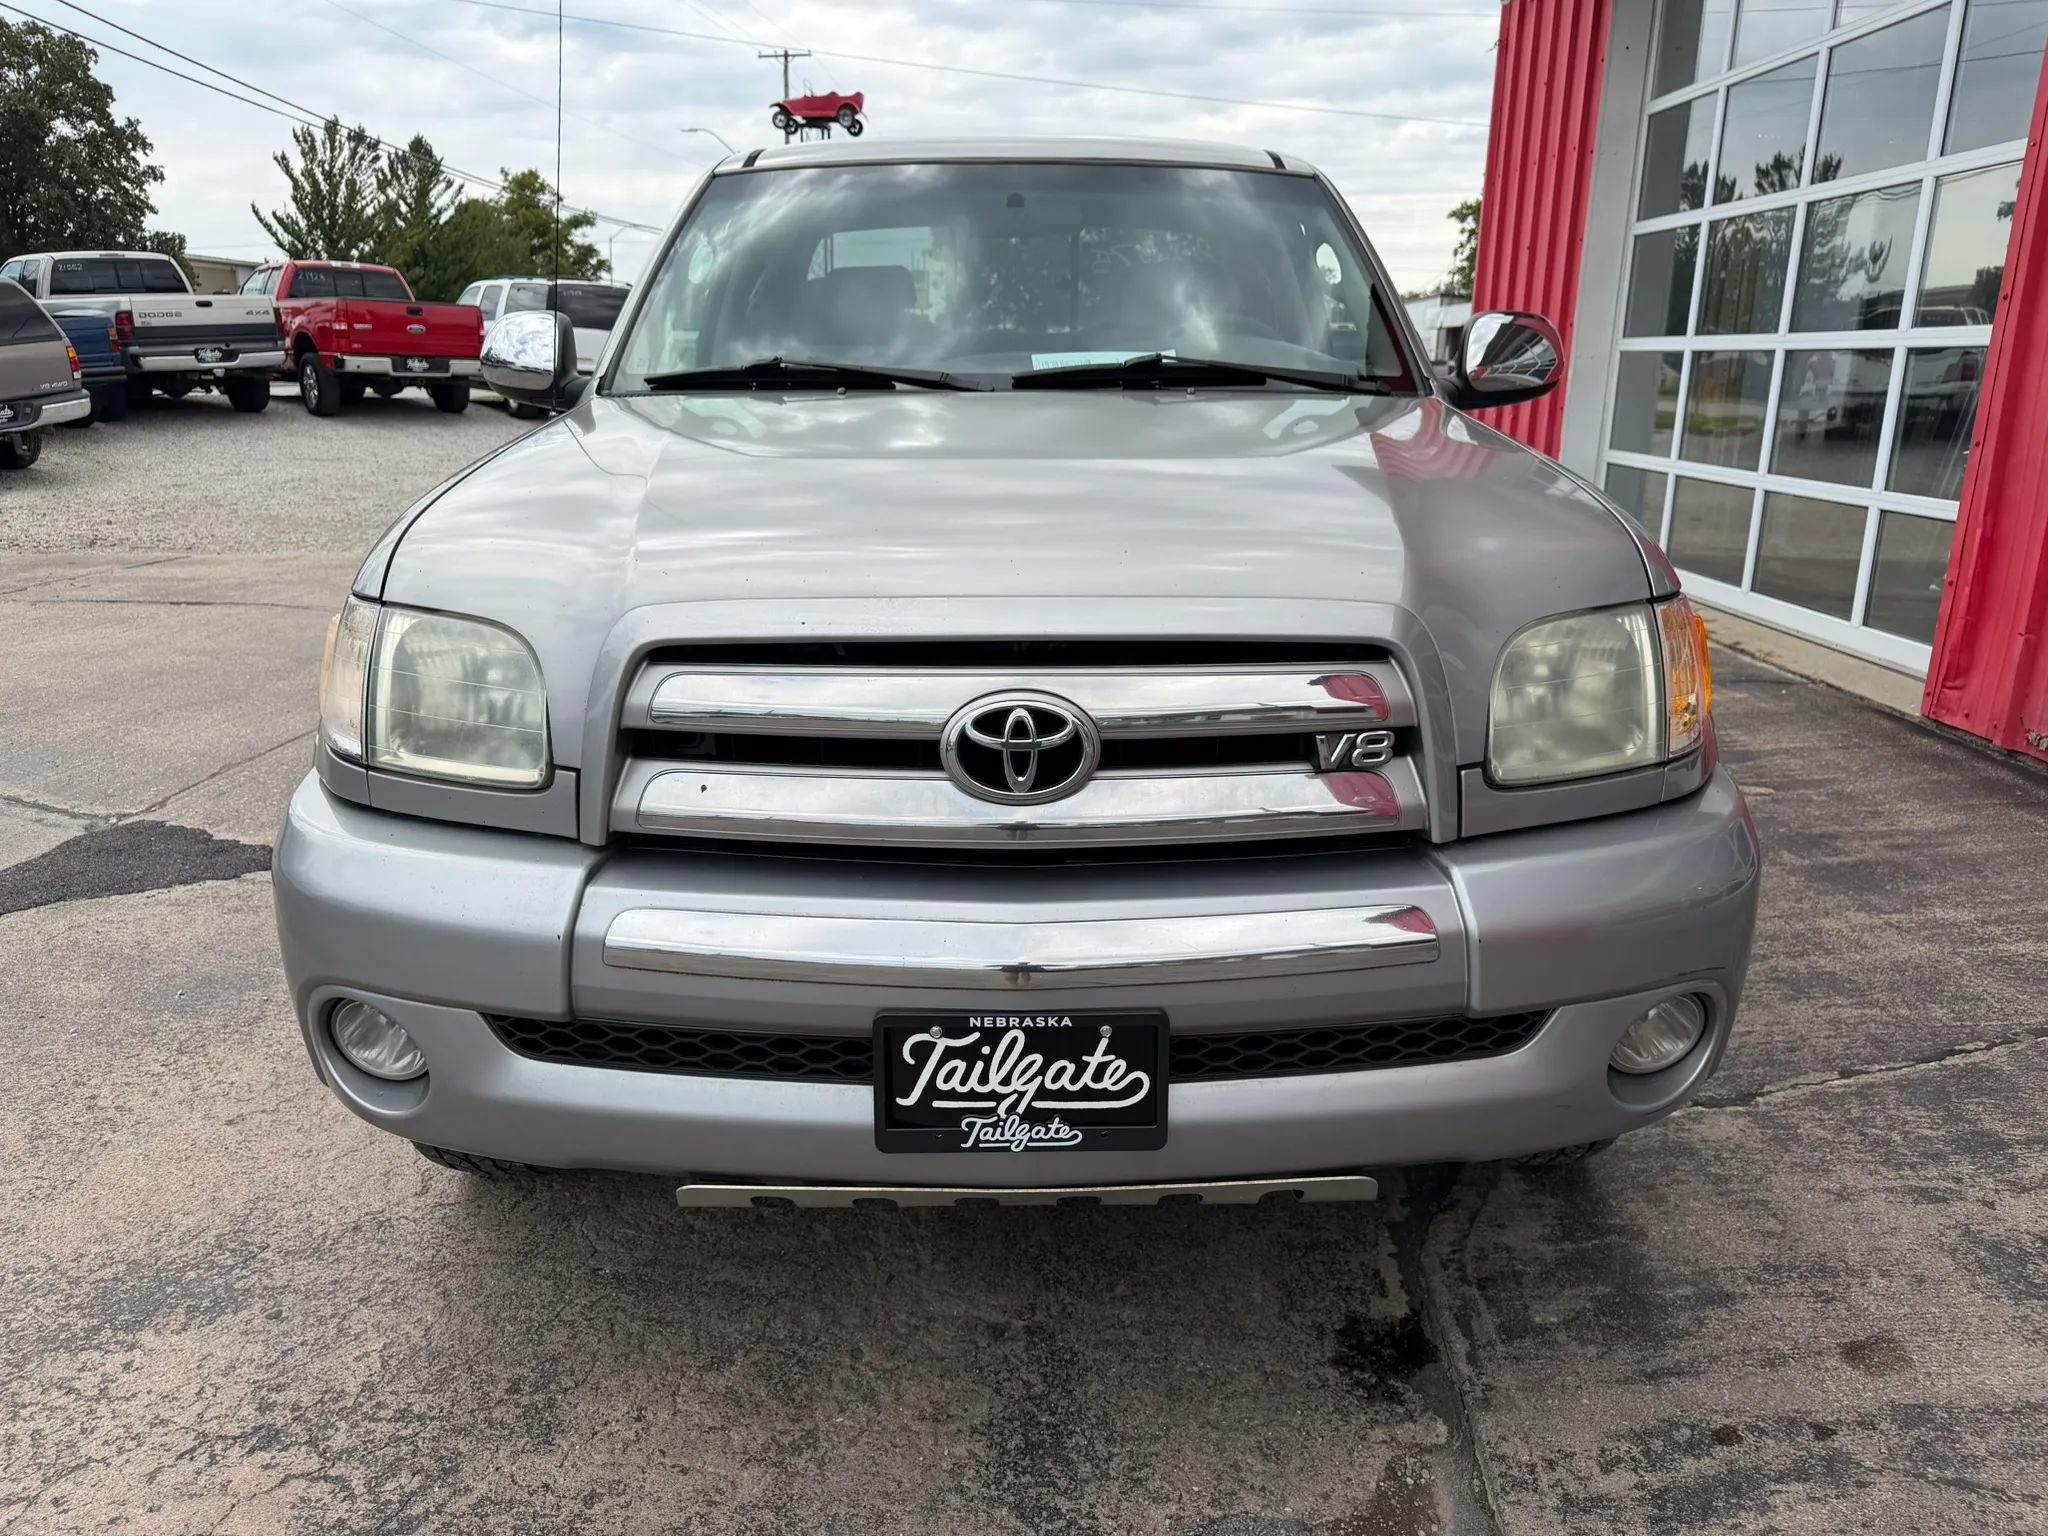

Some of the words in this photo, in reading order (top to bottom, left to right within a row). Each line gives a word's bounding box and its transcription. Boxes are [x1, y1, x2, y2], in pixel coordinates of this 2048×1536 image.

[138, 311, 183, 319] DODGE
[1315, 730, 1396, 770] V8
[969, 1015, 1073, 1028] NEBRASKA
[896, 1028, 1150, 1118] Tailgate
[960, 1115, 1083, 1152] Tailgate
